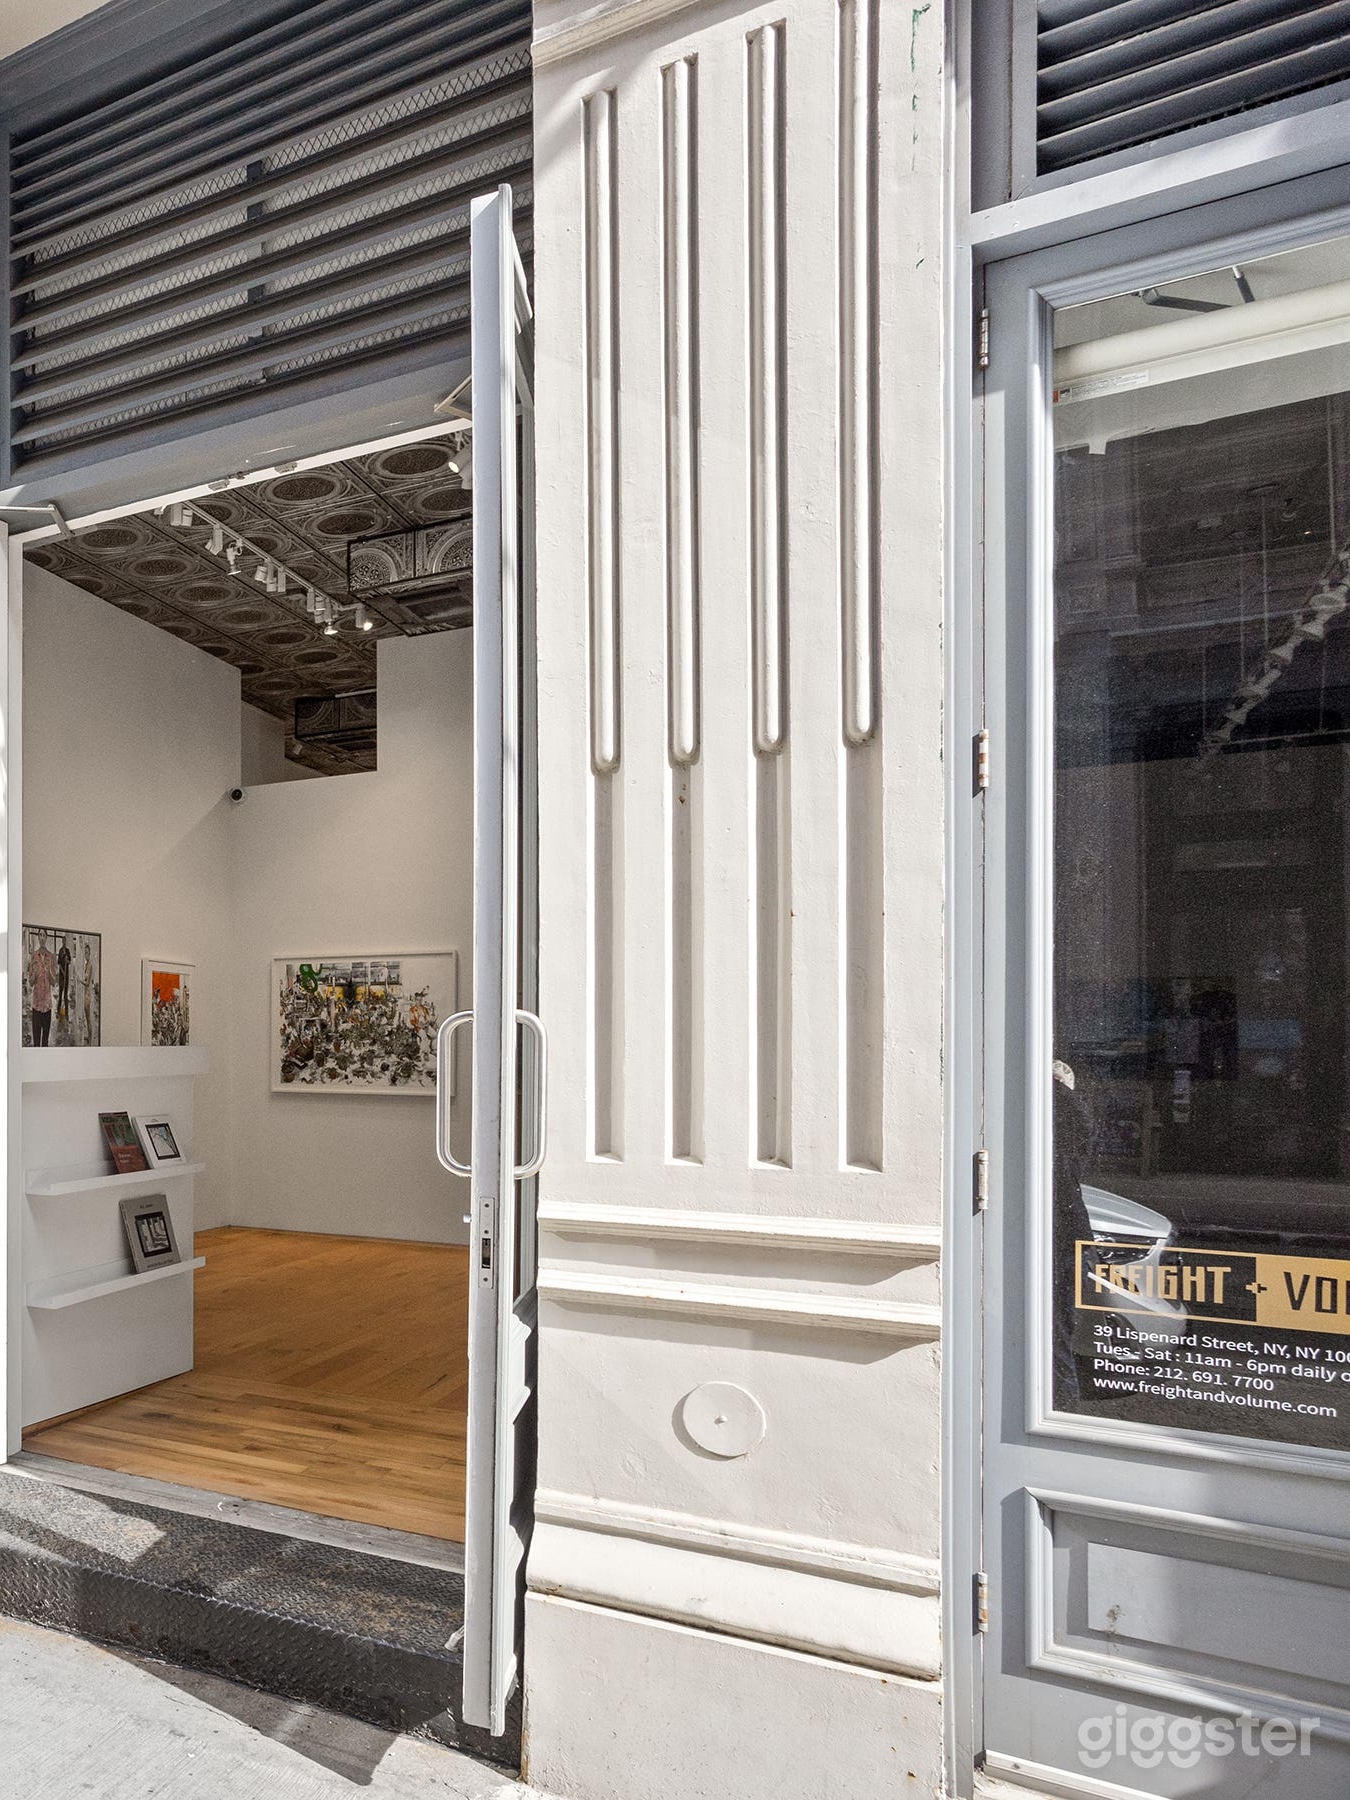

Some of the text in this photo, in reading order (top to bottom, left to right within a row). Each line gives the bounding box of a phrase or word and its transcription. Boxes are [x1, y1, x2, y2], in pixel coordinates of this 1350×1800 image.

[1095, 1264, 1231, 1304] FREIGHT
[1283, 1271, 1350, 1315] VO
[1093, 1325, 1113, 1337] 39
[1116, 1327, 1197, 1347] Lispenard
[1201, 1336, 1259, 1356] Street,
[1263, 1342, 1291, 1359] NY,
[1295, 1346, 1320, 1360] NY
[1093, 1341, 1131, 1356] Tues
[1144, 1347, 1172, 1361] Sat
[1185, 1352, 1232, 1368] 11am
[1246, 1359, 1287, 1374] 6pm
[1291, 1364, 1337, 1383] daily
[1093, 1358, 1274, 1391] Phone: 212. 691. 7700
[1093, 1378, 1337, 1418] www.freightandvolume.com
